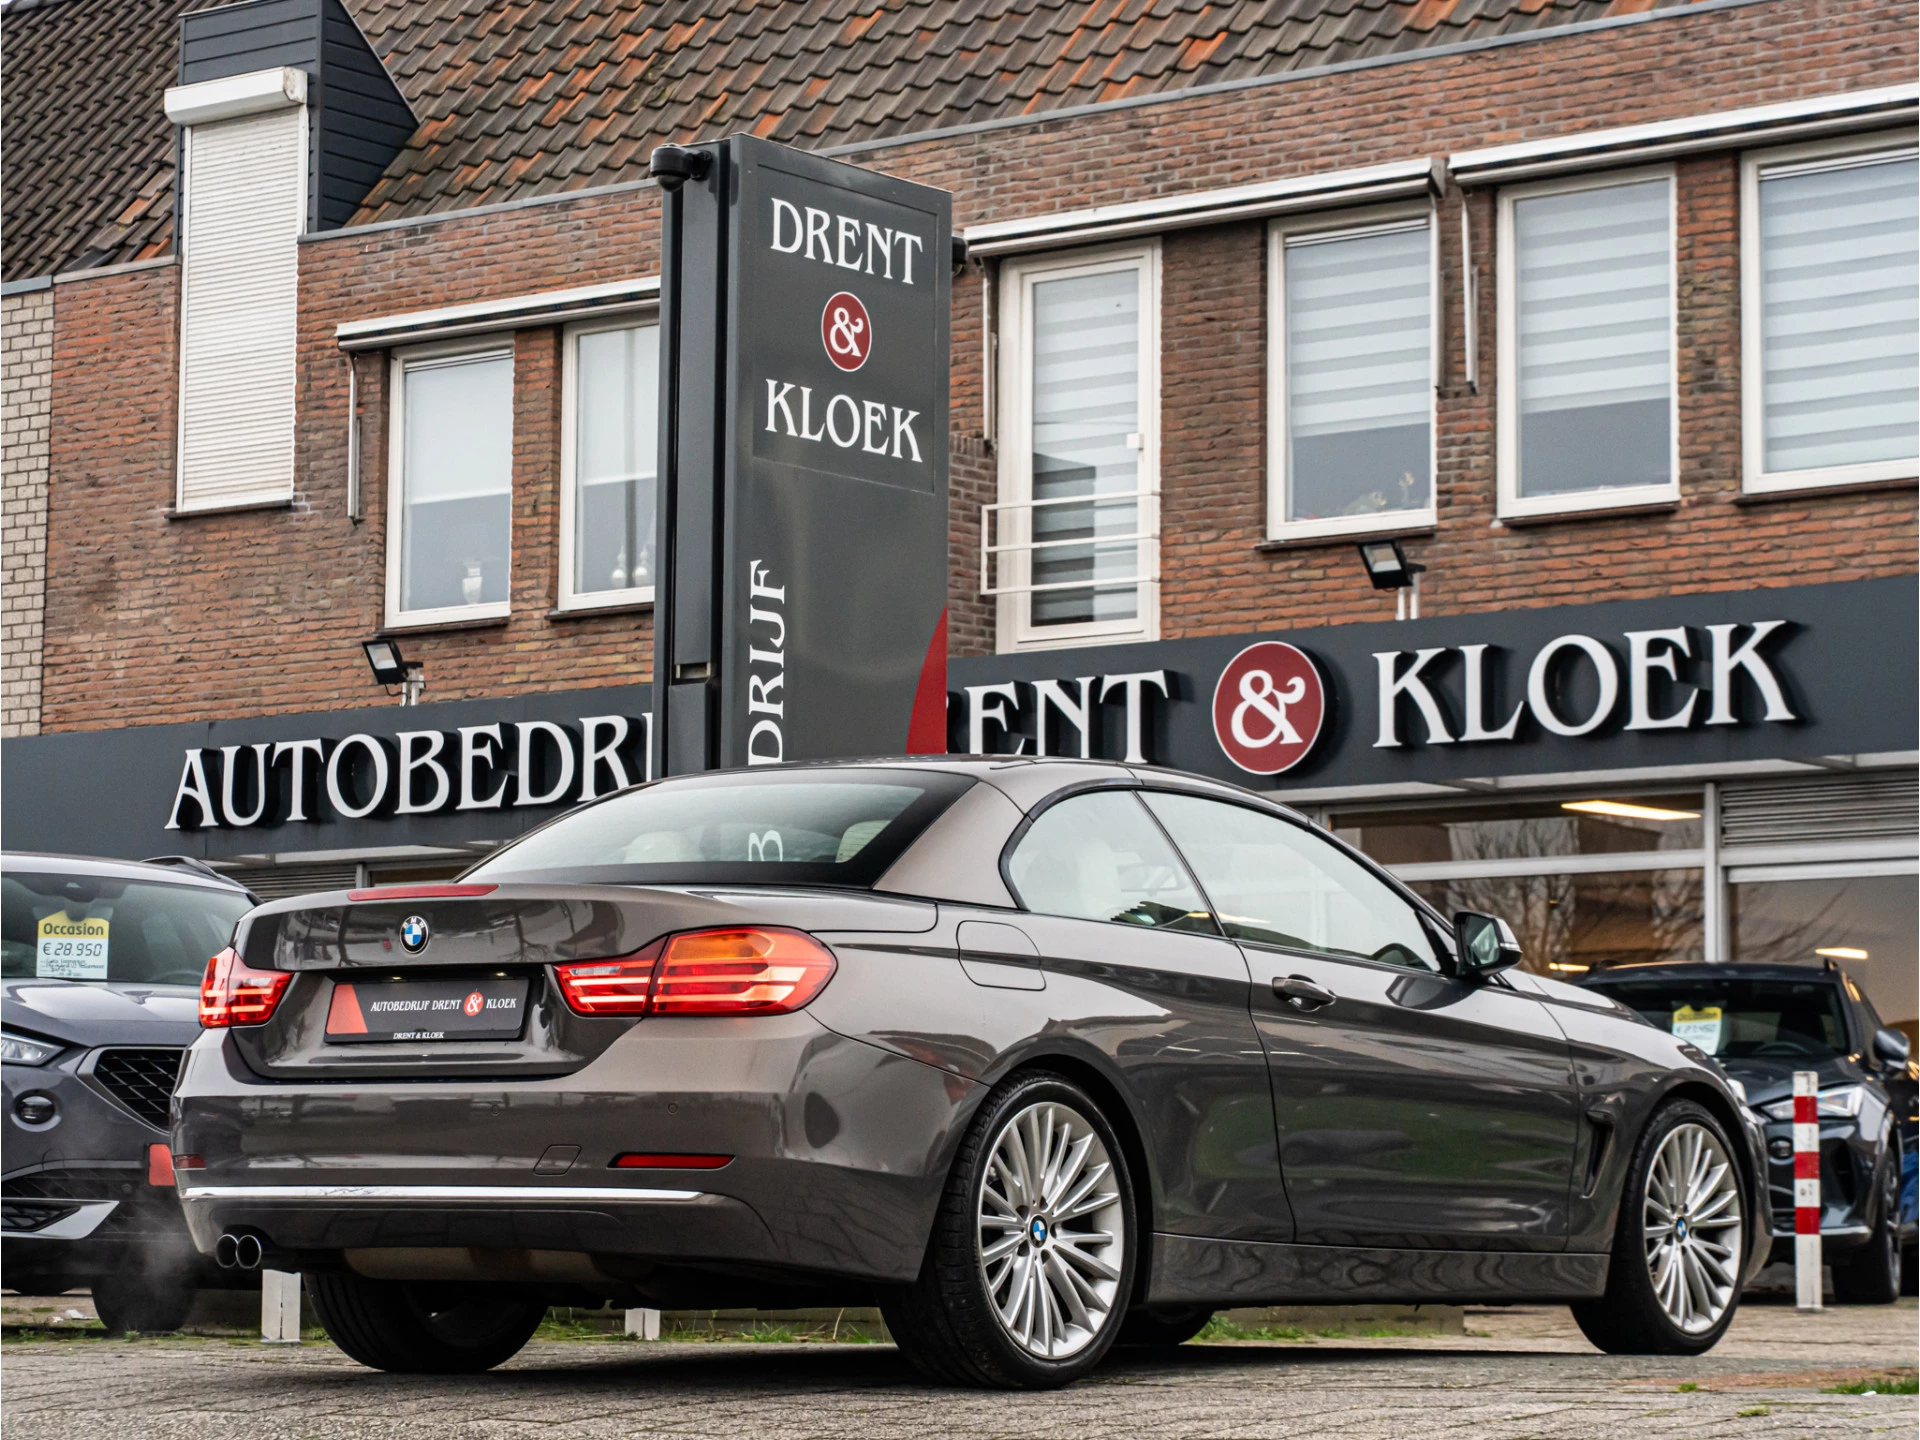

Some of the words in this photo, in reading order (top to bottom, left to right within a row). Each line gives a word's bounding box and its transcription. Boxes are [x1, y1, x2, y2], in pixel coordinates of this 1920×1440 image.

[771, 198, 922, 284] DRENT
[829, 307, 864, 357] &
[765, 378, 923, 462] KLOEK
[946, 670, 1169, 764] ENT
[1231, 669, 1306, 749] &
[1372, 620, 1796, 748] KLOEK
[43, 923, 104, 936] Occasion
[54, 943, 102, 957] 28.950
[370, 1000, 430, 1012] AUTOBEDRIJF
[431, 999, 461, 1010] DRENT
[467, 994, 482, 1013] &
[486, 998, 517, 1009] KLOEK
[393, 1032, 416, 1040] DRENT
